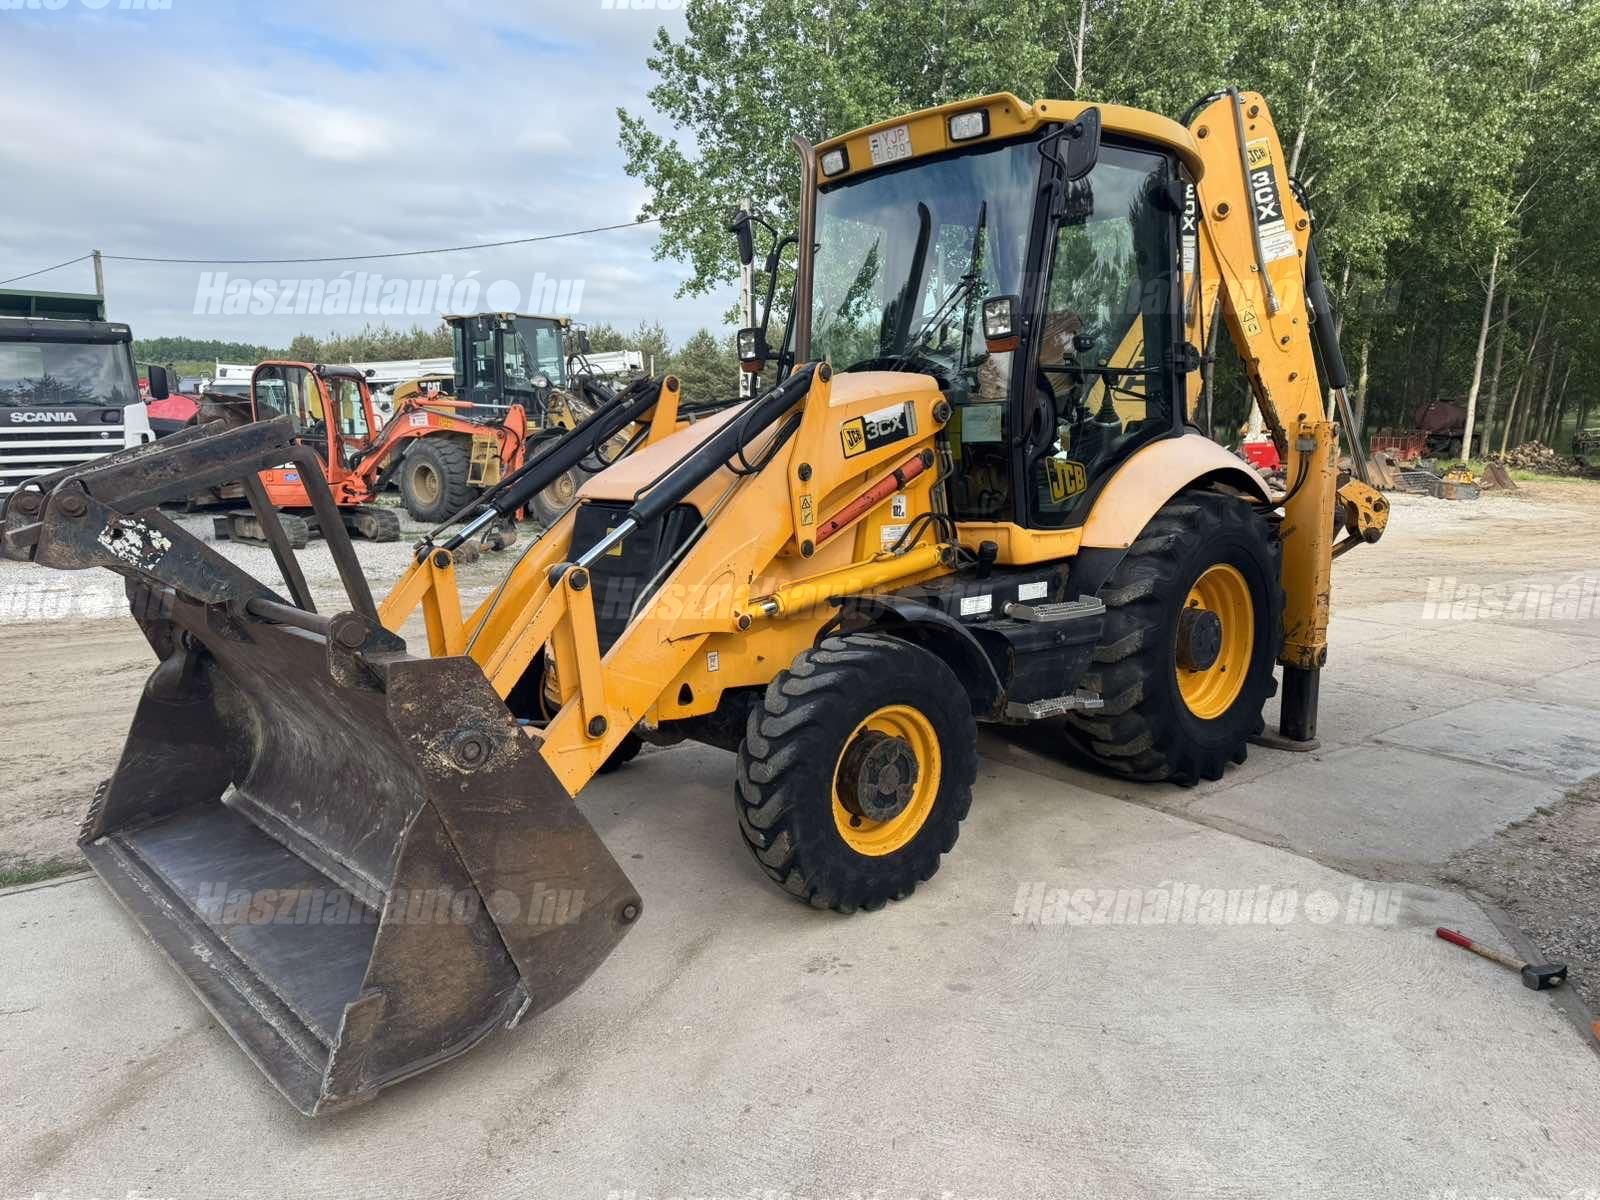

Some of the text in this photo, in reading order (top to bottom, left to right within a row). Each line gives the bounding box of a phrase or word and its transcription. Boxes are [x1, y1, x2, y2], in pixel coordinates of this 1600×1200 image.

[887, 143, 905, 160] 679
[1247, 147, 1266, 164] JCB
[1251, 170, 1279, 221] 3CX
[10, 411, 78, 423] SCANIA
[865, 415, 905, 441] 3CX
[845, 429, 863, 448] JCB
[1049, 460, 1086, 500] JCB
